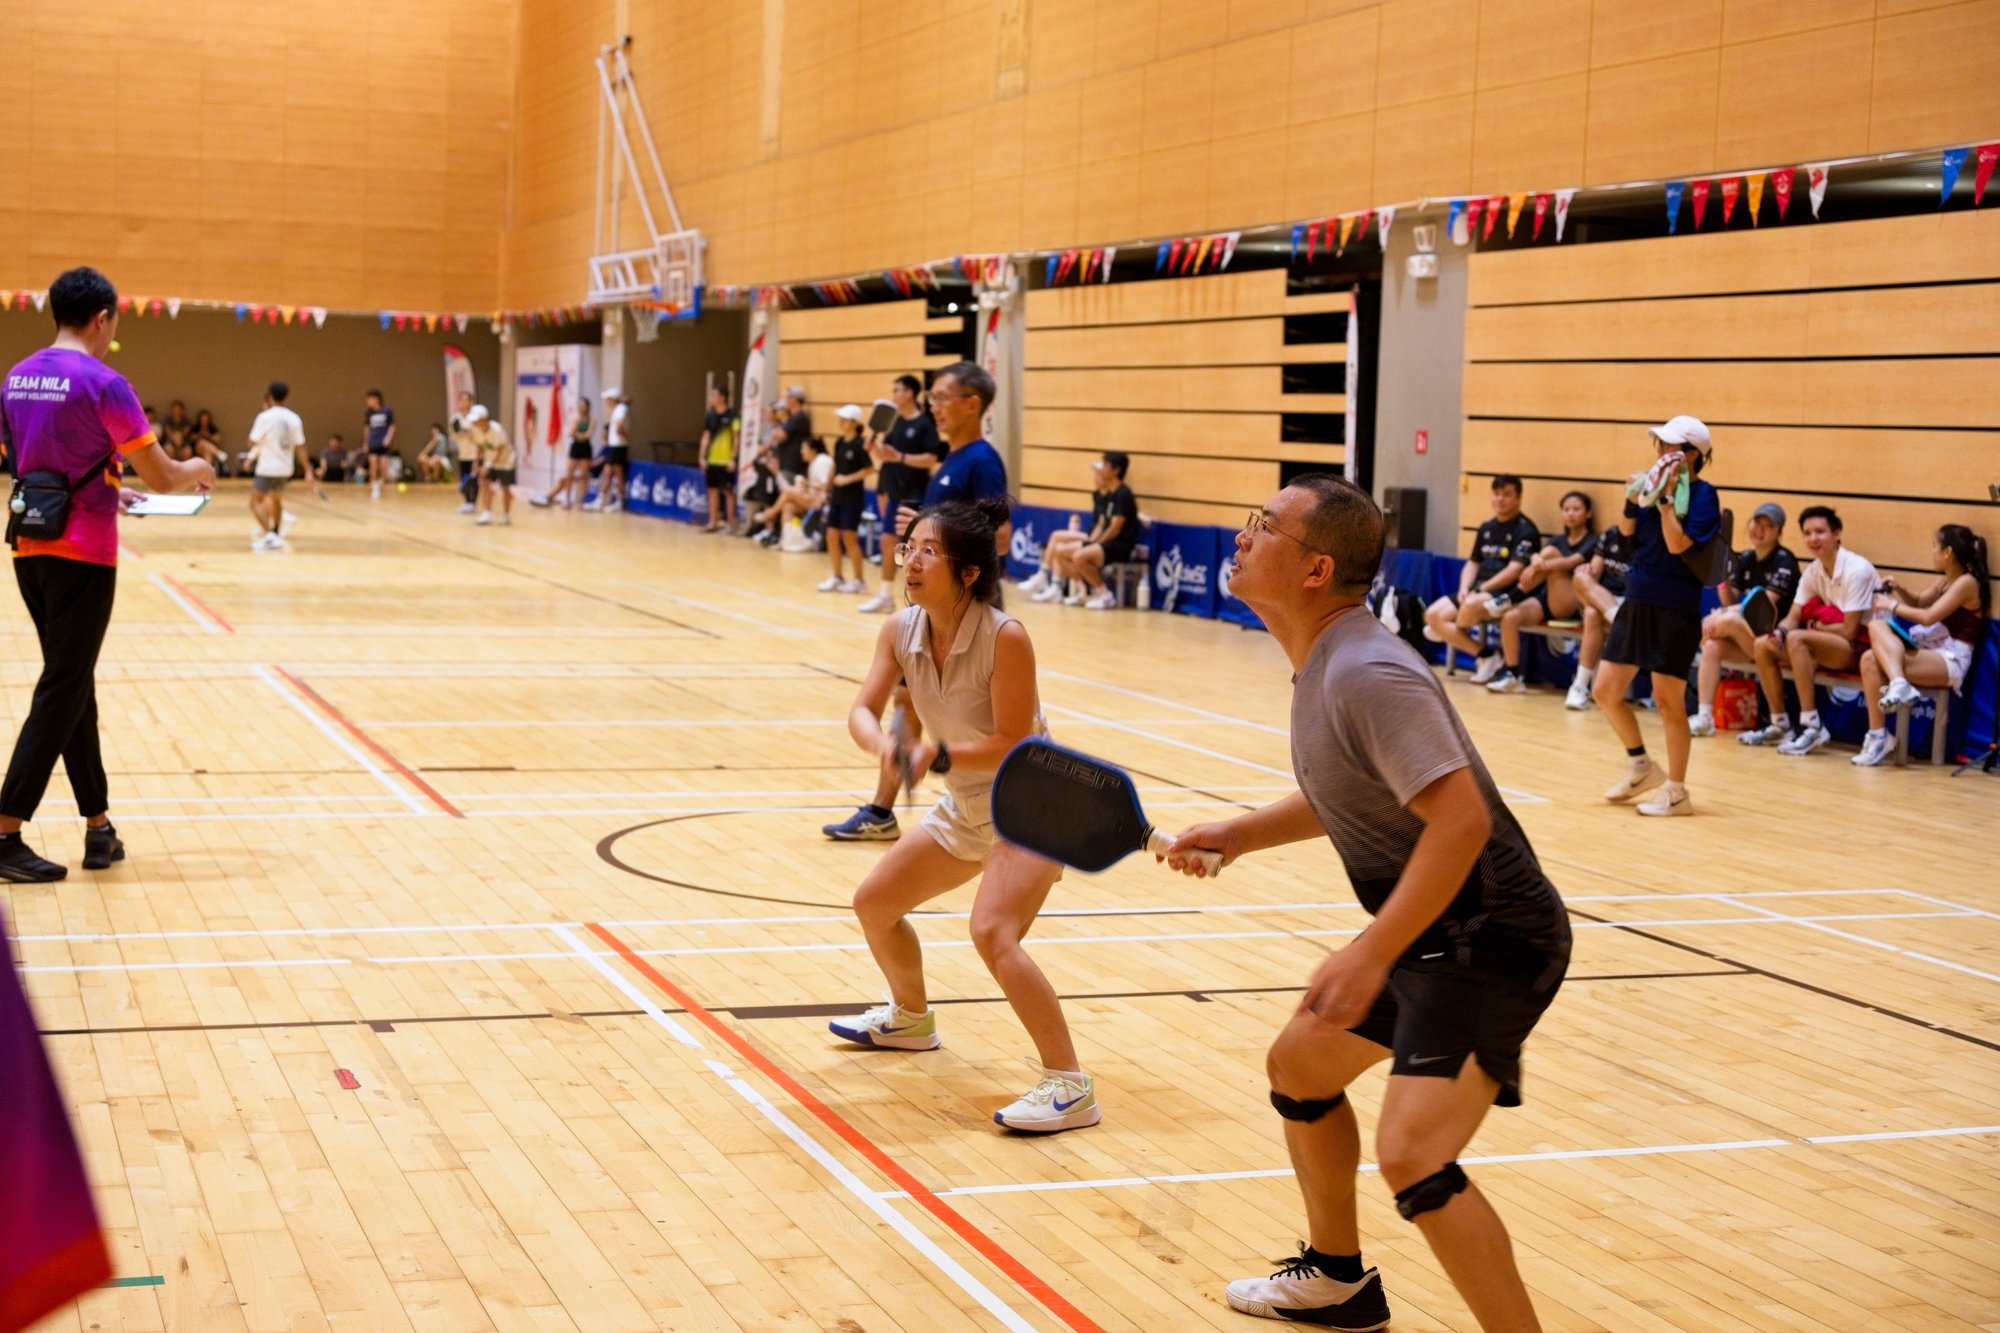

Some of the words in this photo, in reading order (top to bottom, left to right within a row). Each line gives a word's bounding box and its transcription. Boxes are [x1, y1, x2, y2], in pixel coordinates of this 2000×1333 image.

[9, 375, 39, 389] TEAM
[40, 377, 70, 391] NILA
[8, 391, 28, 401] SPORT
[29, 391, 66, 402] VOLUNTEER
